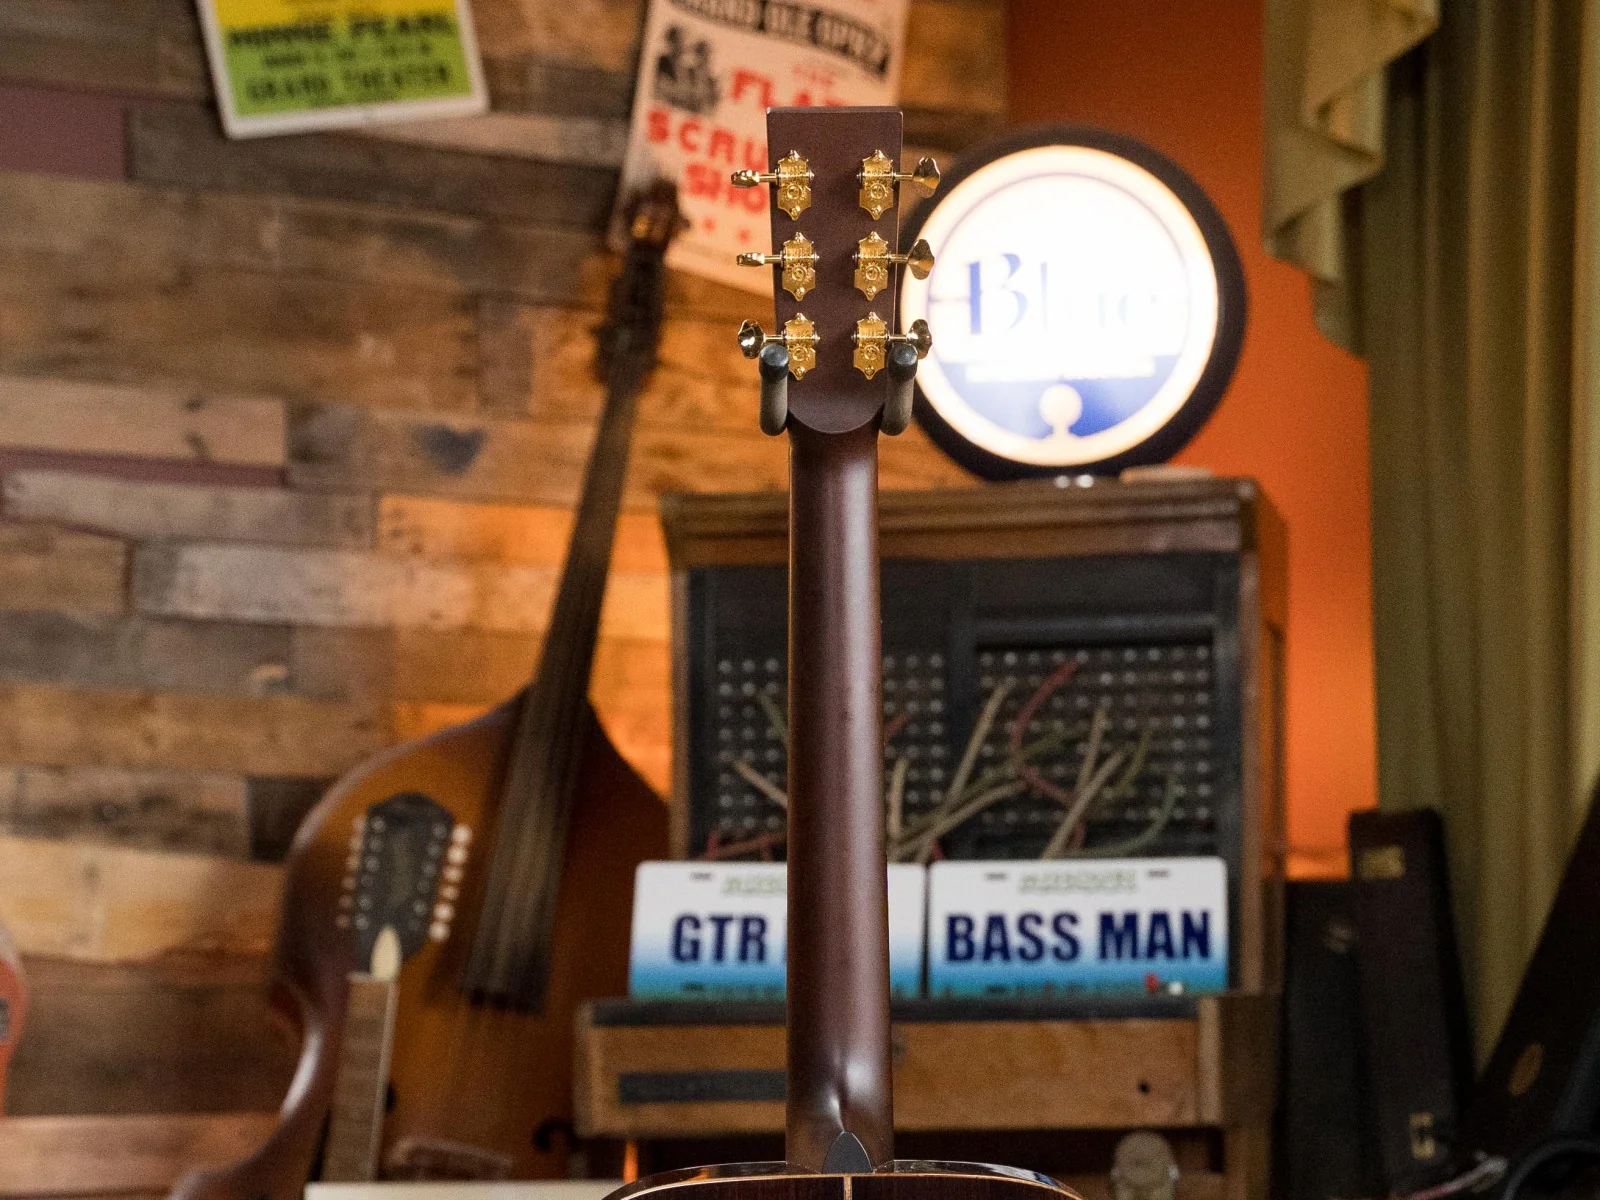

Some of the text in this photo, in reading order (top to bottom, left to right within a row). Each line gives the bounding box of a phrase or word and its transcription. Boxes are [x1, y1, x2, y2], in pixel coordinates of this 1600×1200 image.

[646, 108, 769, 172] SCRU
[671, 912, 767, 964] GTR
[946, 909, 1212, 963] BASS MAN
